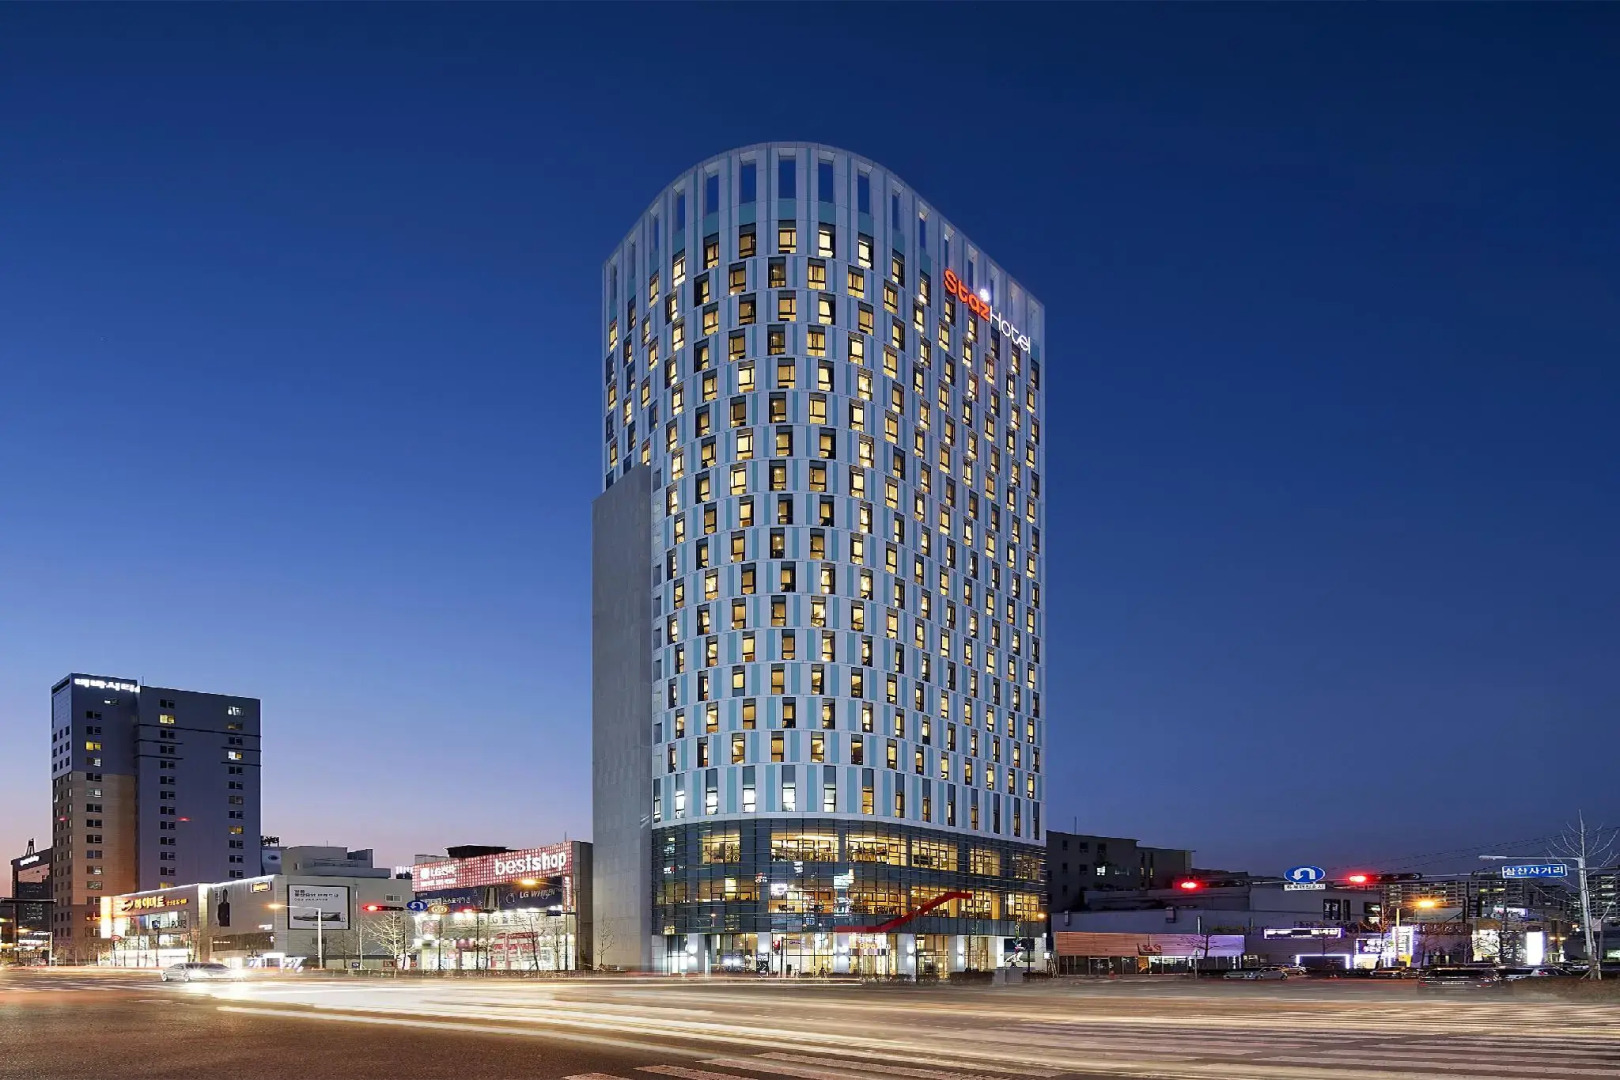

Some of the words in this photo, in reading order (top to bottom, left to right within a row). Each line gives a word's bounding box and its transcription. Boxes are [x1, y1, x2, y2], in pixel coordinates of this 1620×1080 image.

[944, 268, 990, 321] Staz
[989, 305, 1031, 354] Hotel
[495, 851, 566, 875] bestshop
[1506, 866, 1564, 876] 삼산사거리
